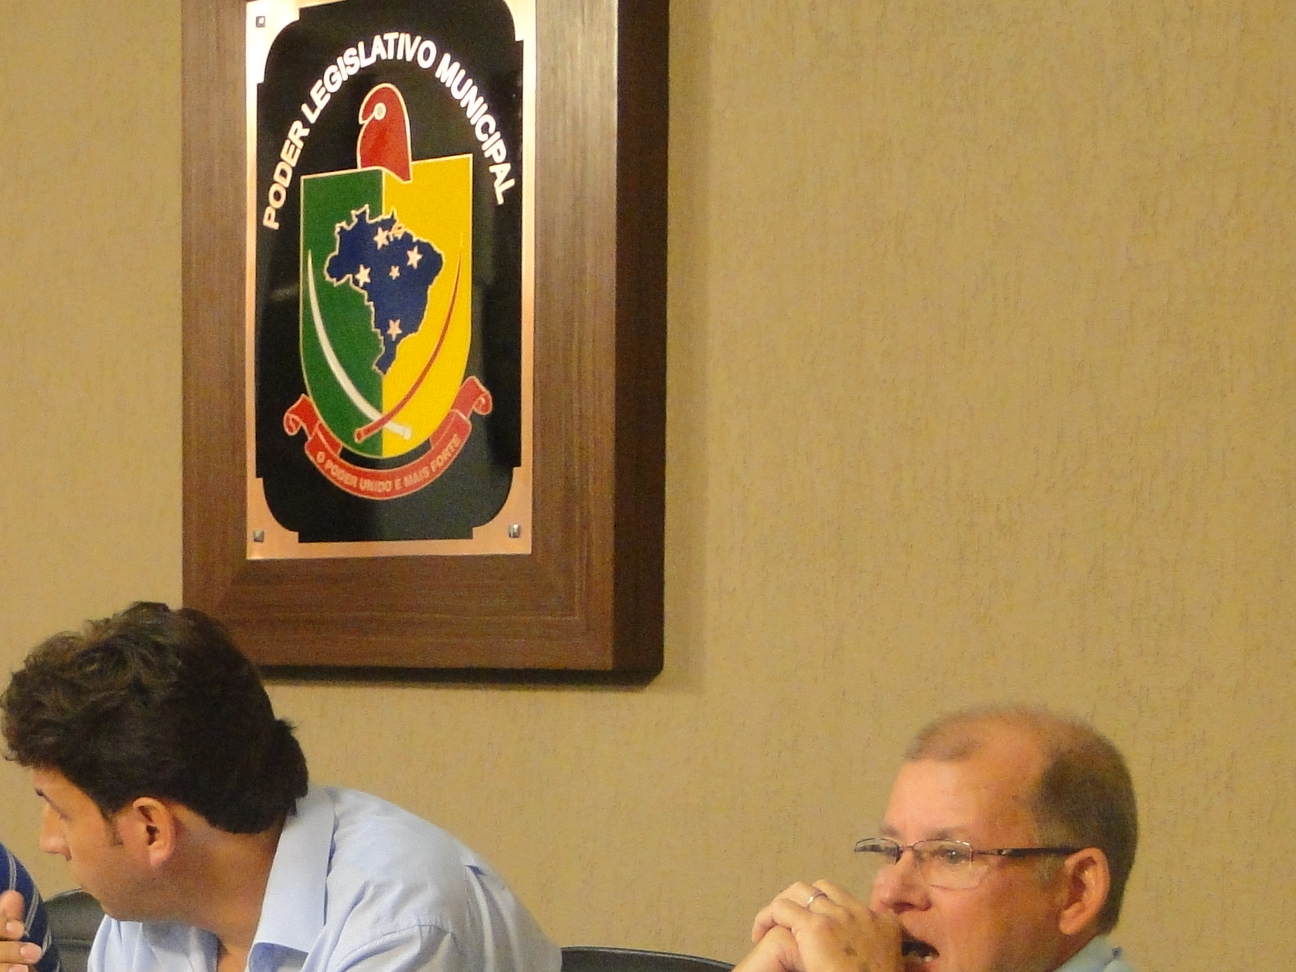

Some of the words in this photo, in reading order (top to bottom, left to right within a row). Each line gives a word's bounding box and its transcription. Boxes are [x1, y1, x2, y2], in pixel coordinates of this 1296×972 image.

[263, 120, 310, 230] PODER
[301, 32, 437, 124] LEGISLATIVO
[435, 53, 516, 205] MUNICIPAL
[404, 466, 430, 487] MAIS
[430, 433, 462, 472] FORTE
